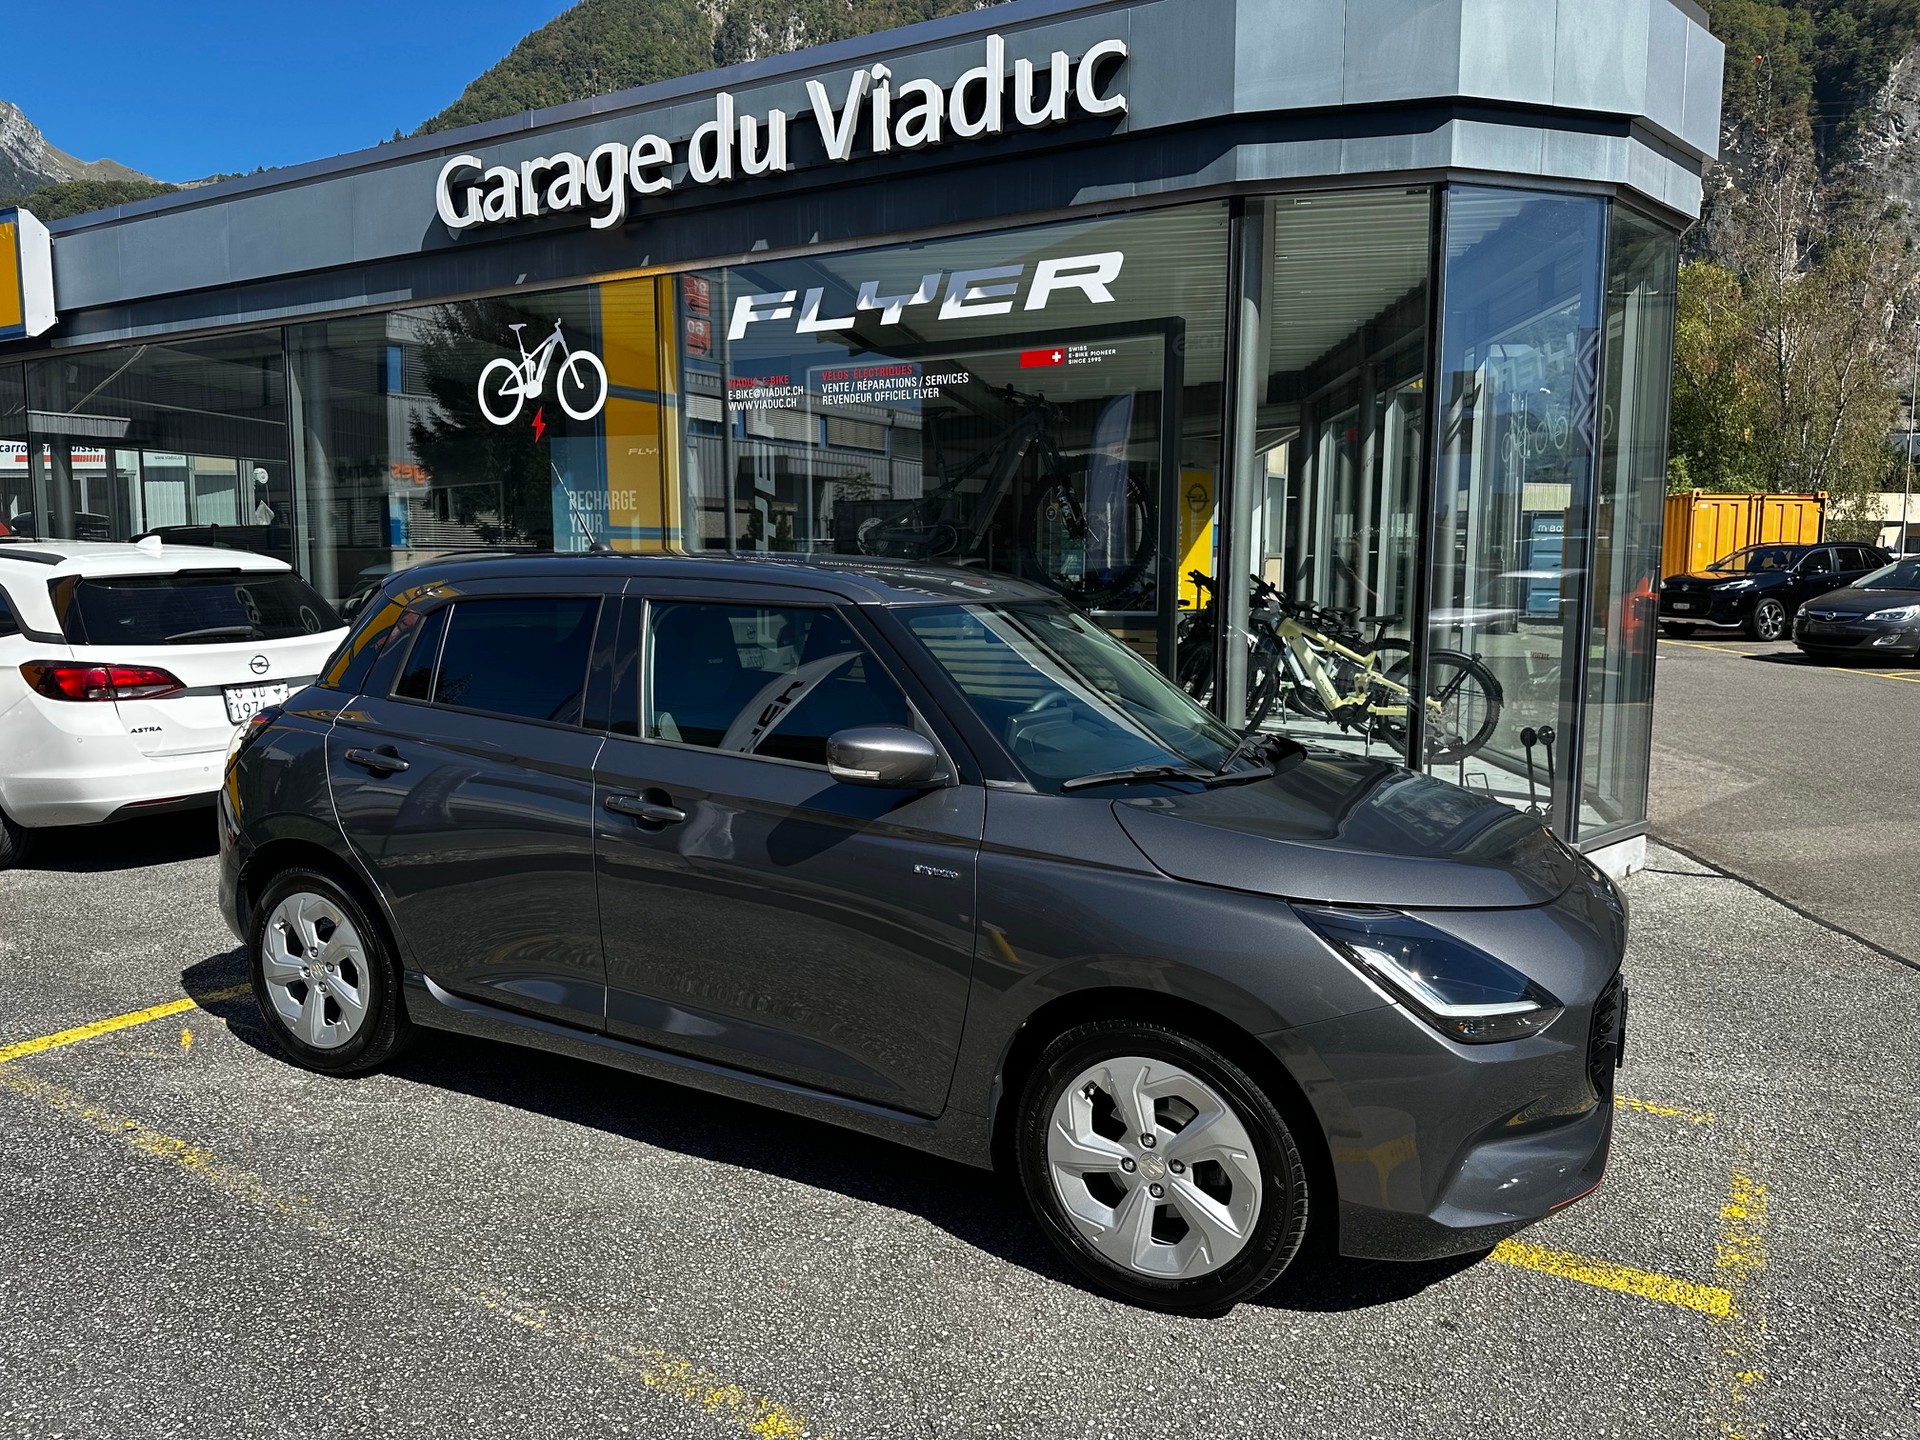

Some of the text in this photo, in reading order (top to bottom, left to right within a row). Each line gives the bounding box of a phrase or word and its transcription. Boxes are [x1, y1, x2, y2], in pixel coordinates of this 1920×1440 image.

[436, 33, 1128, 229] Garage du Viaduc
[727, 251, 1125, 341] FLYER
[728, 377, 758, 389] VIADUC
[728, 385, 804, 400] E-BIKE@VIADUC.CH
[822, 382, 850, 394] VENTE
[857, 377, 917, 391] RÉPARATIONS
[925, 372, 969, 386] SERVICES
[822, 387, 940, 406] REVENDEUR OFFICIEL FLYER
[628, 447, 659, 456] FLY
[568, 489, 638, 511] RECHARGE
[568, 513, 604, 534] YOUR
[570, 535, 597, 552] LIF
[130, 726, 162, 734] ASTRA
